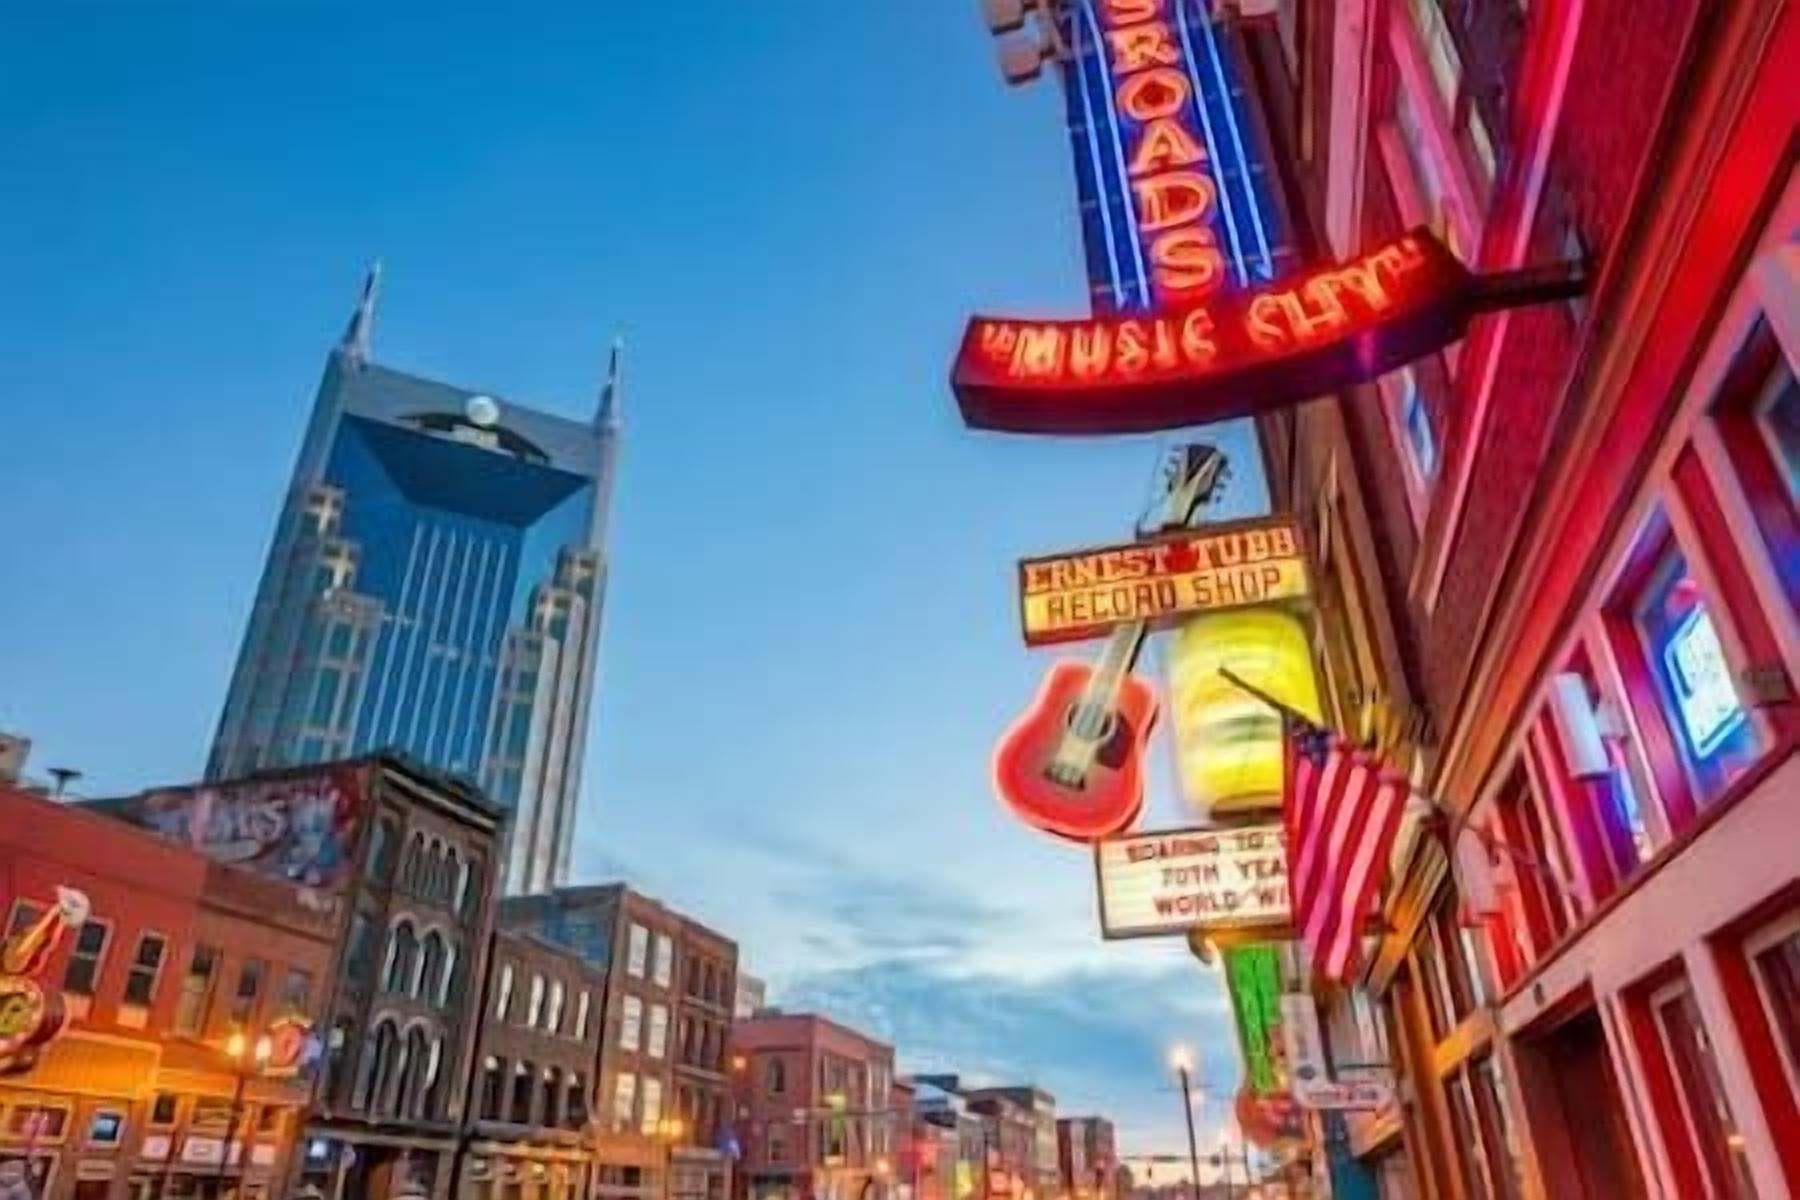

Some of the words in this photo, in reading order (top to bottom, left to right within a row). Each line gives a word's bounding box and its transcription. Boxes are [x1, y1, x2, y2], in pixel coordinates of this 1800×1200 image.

[1025, 543, 1169, 591] ERNEST
[1190, 526, 1297, 569] TUBB
[1047, 578, 1177, 622] RECORD
[1192, 566, 1281, 606] SHOP
[1232, 857, 1287, 880] YEA
[1255, 884, 1287, 908] WI
